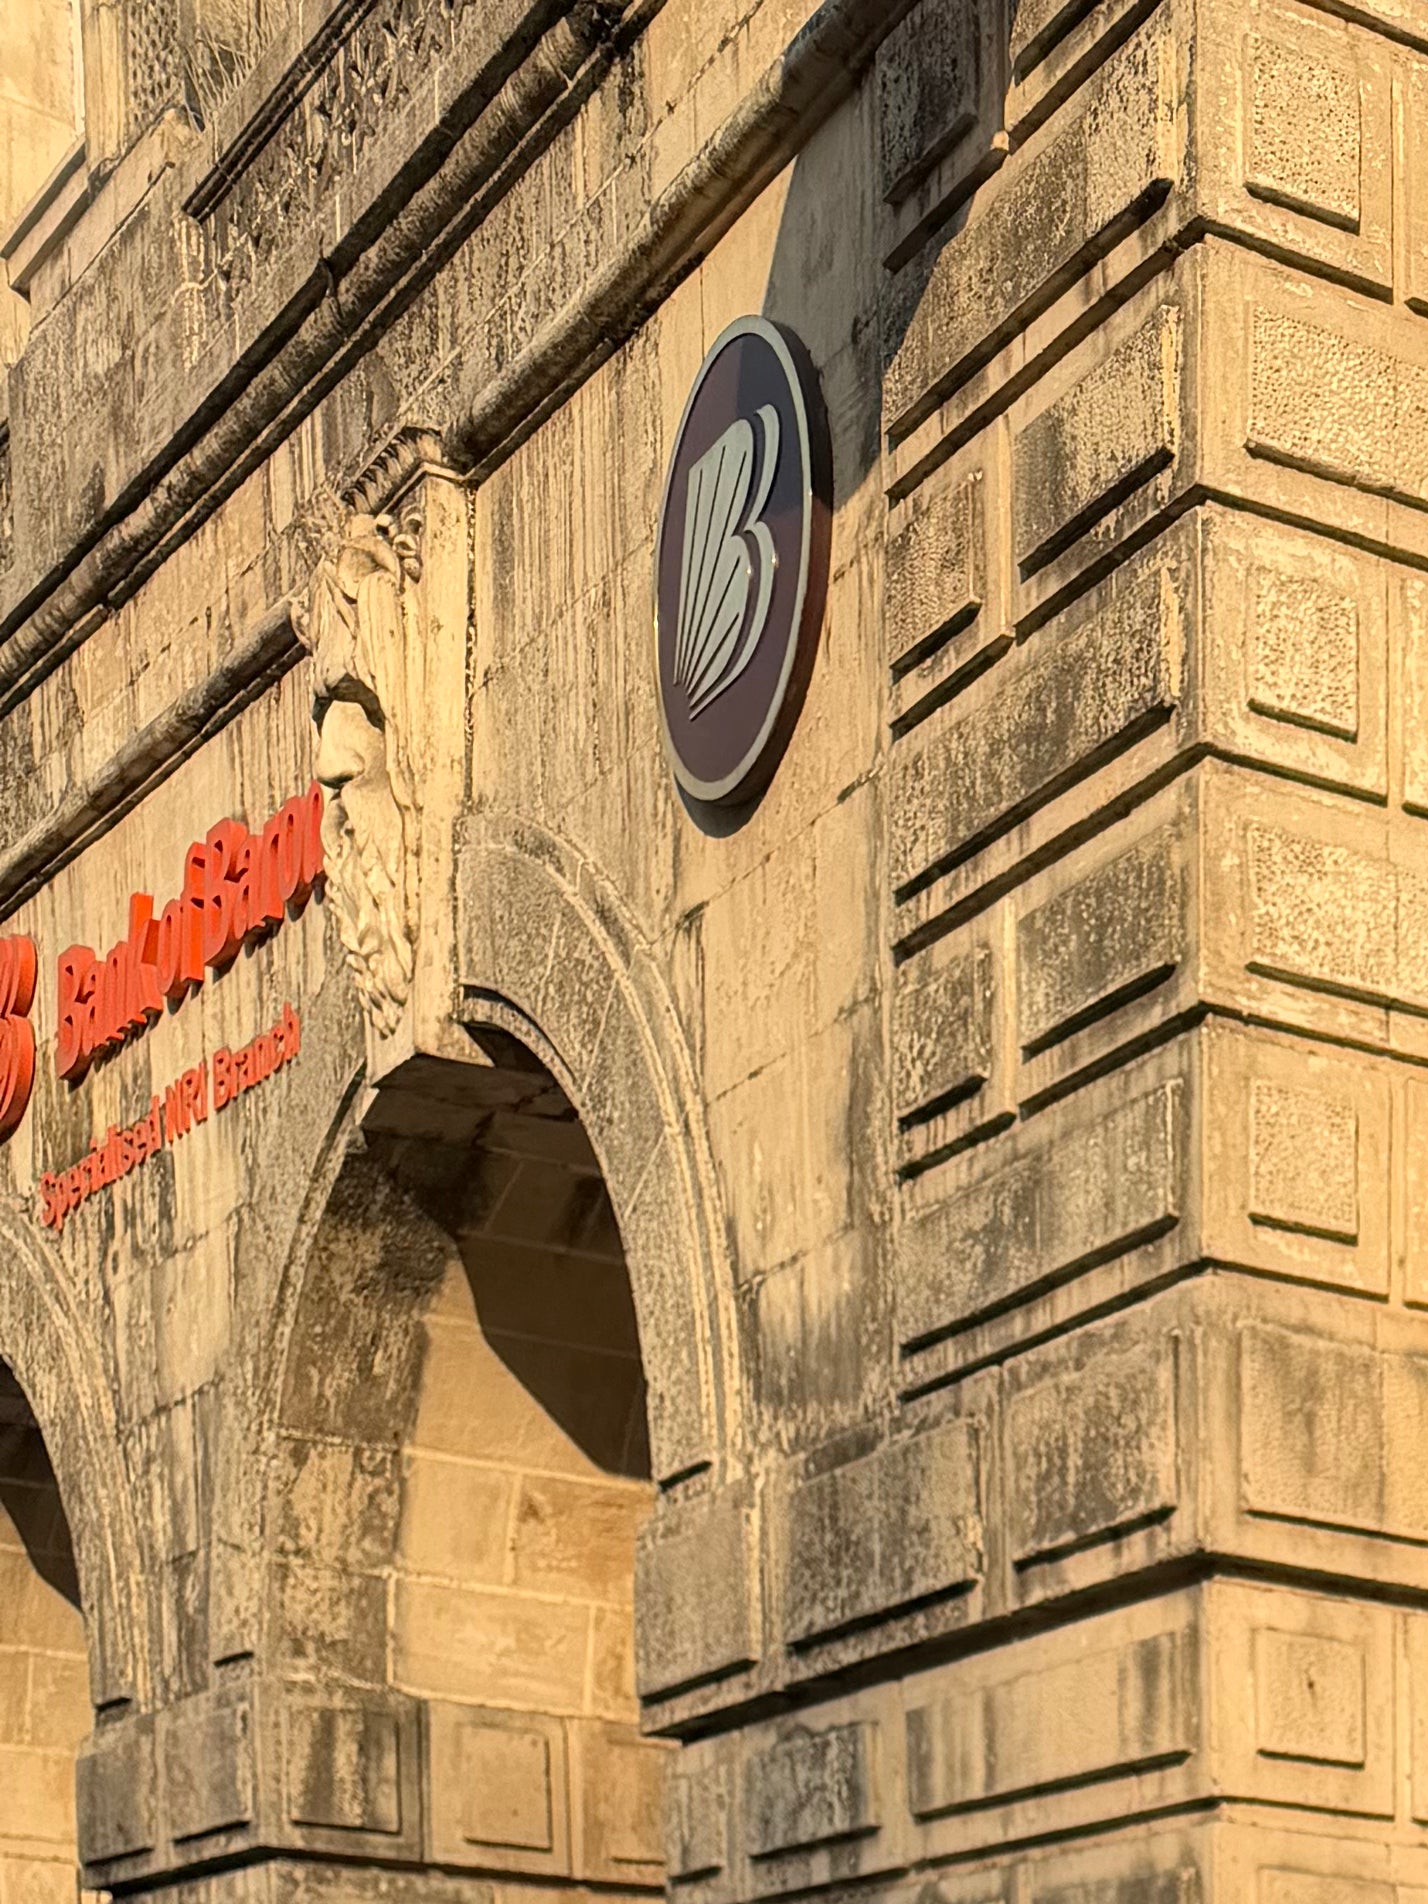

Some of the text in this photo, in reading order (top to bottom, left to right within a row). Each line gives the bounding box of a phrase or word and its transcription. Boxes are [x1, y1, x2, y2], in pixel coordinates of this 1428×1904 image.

[54, 892, 163, 1079] Bank
[158, 841, 206, 997] of
[204, 779, 326, 967] Baro
[40, 1002, 300, 1232] Specialised NRI Branch
